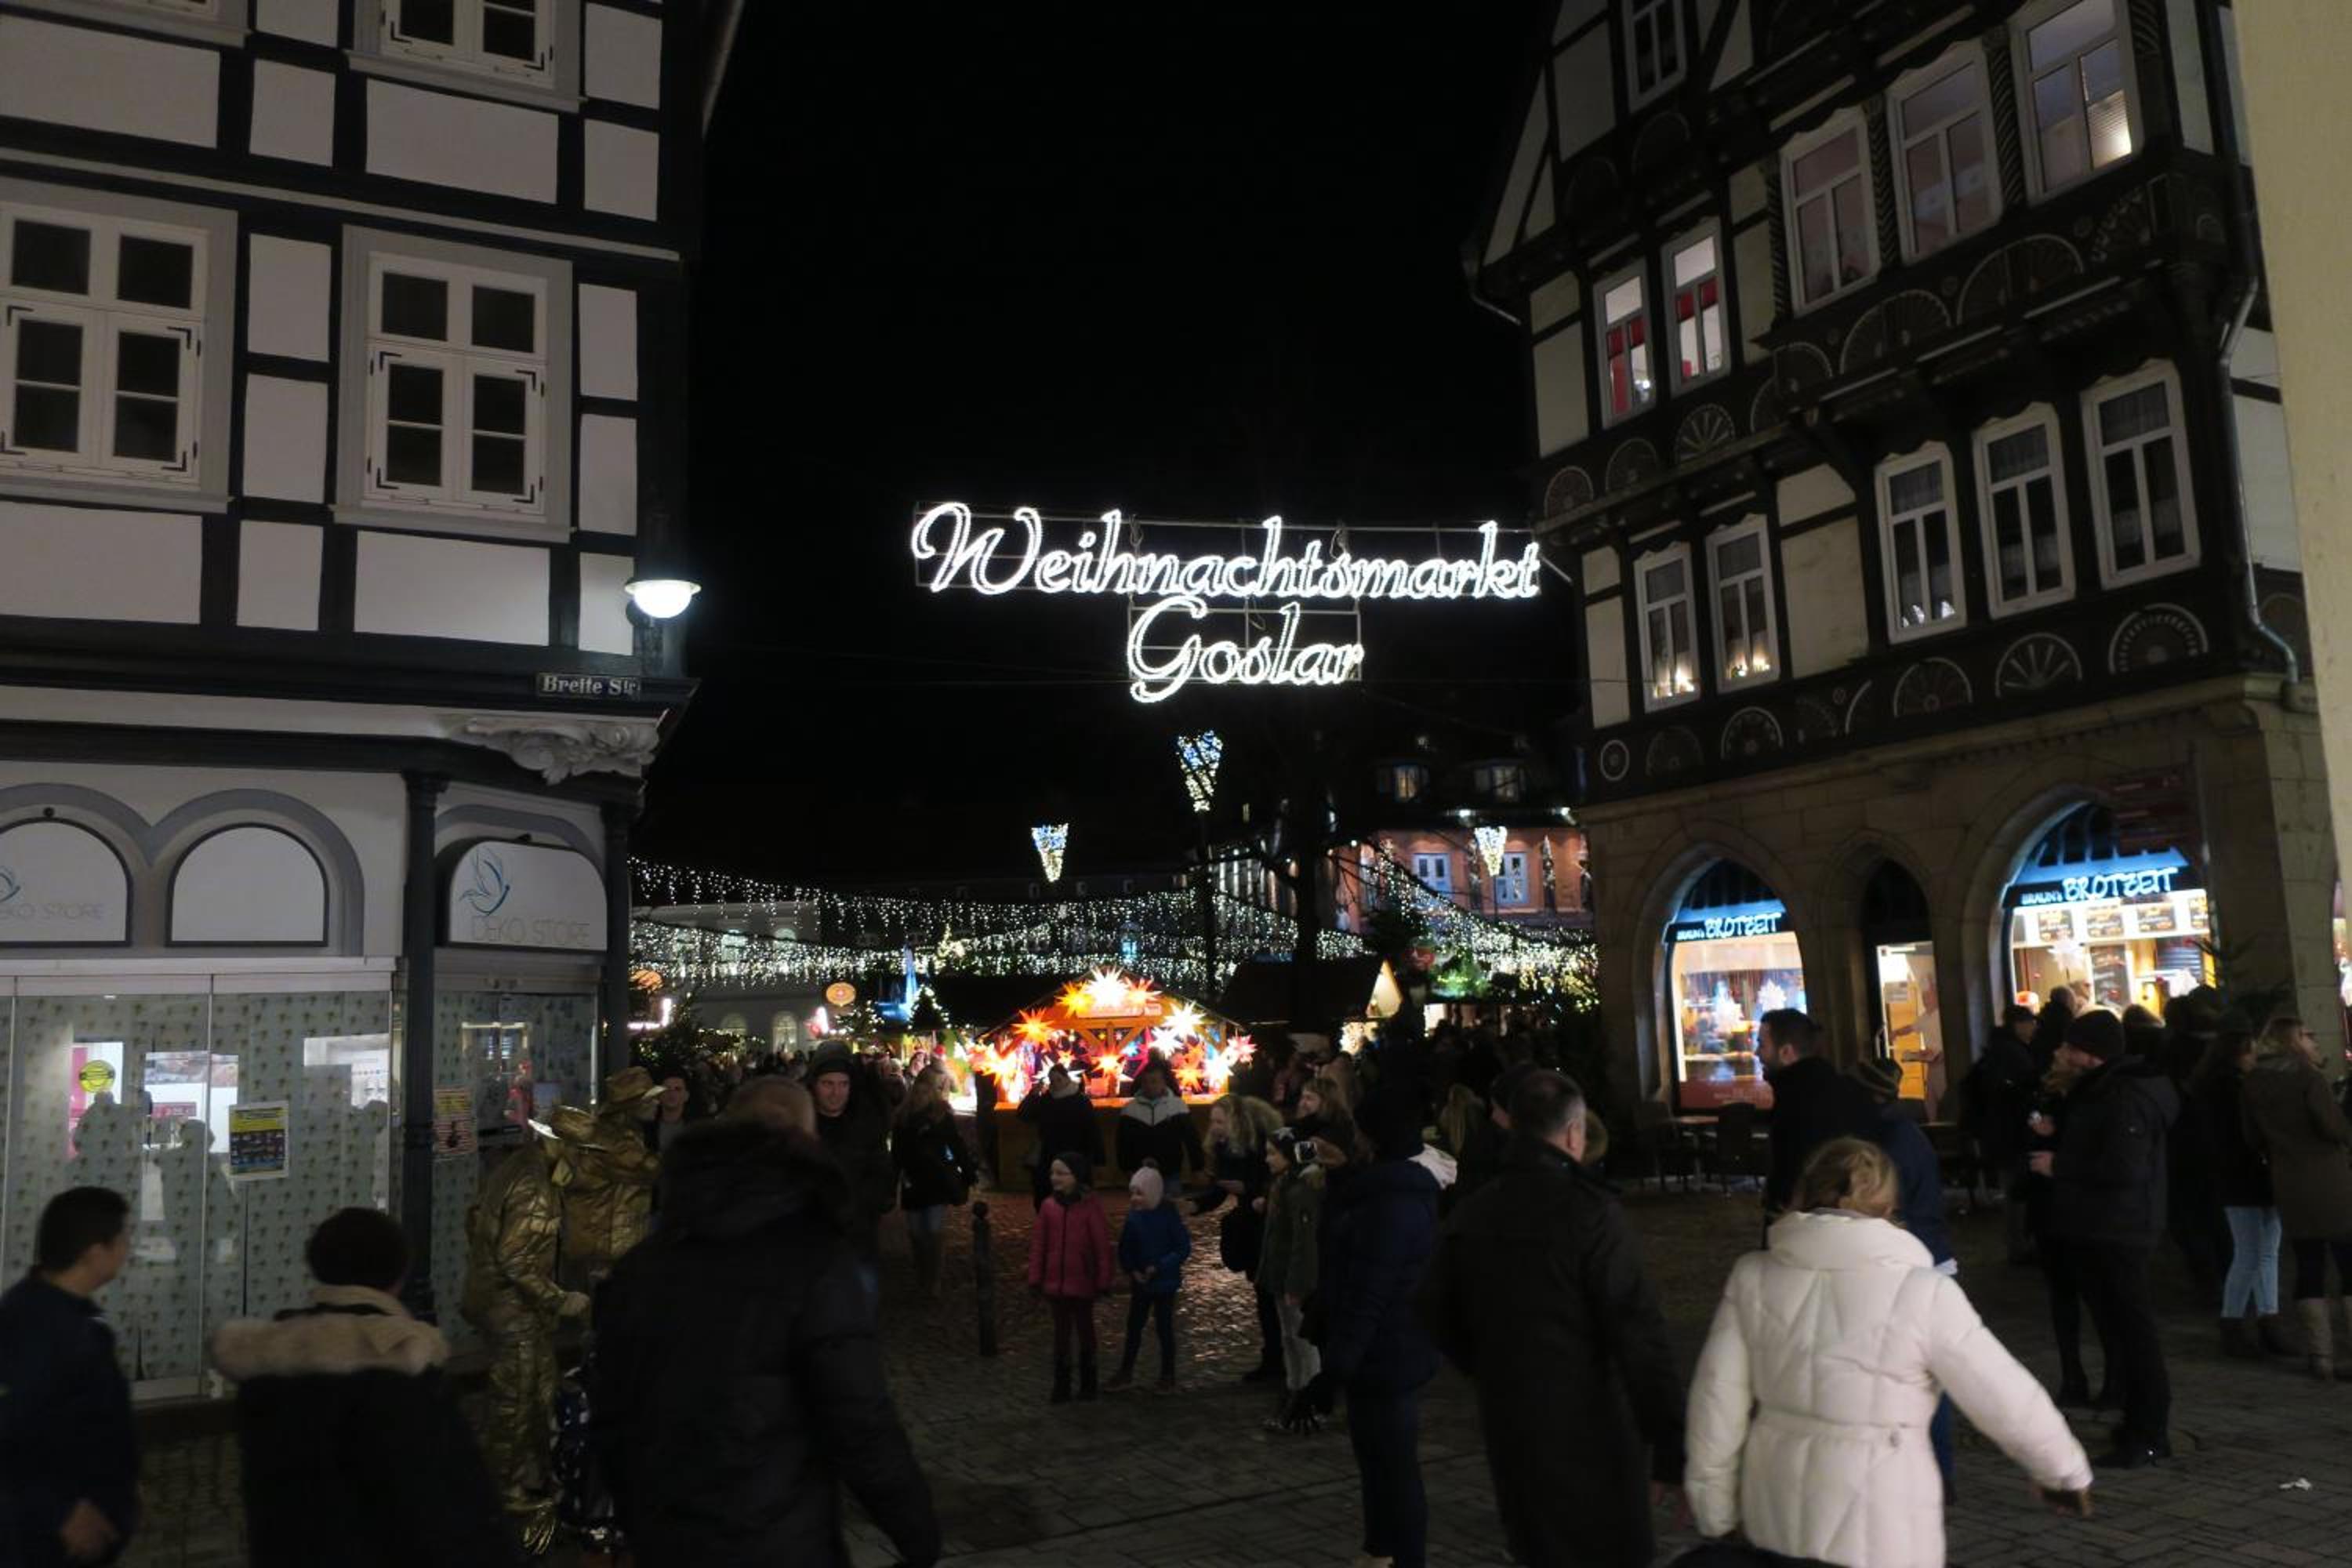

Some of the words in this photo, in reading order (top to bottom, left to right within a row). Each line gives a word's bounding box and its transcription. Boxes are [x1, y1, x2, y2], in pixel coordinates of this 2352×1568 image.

[909, 501, 1541, 600] Weihnachtsmarkt
[1124, 596, 1365, 704] Goslar
[542, 675, 603, 695] Breite
[2062, 867, 2179, 901] BROTZEIT
[1704, 912, 1782, 938] BROTZEIT
